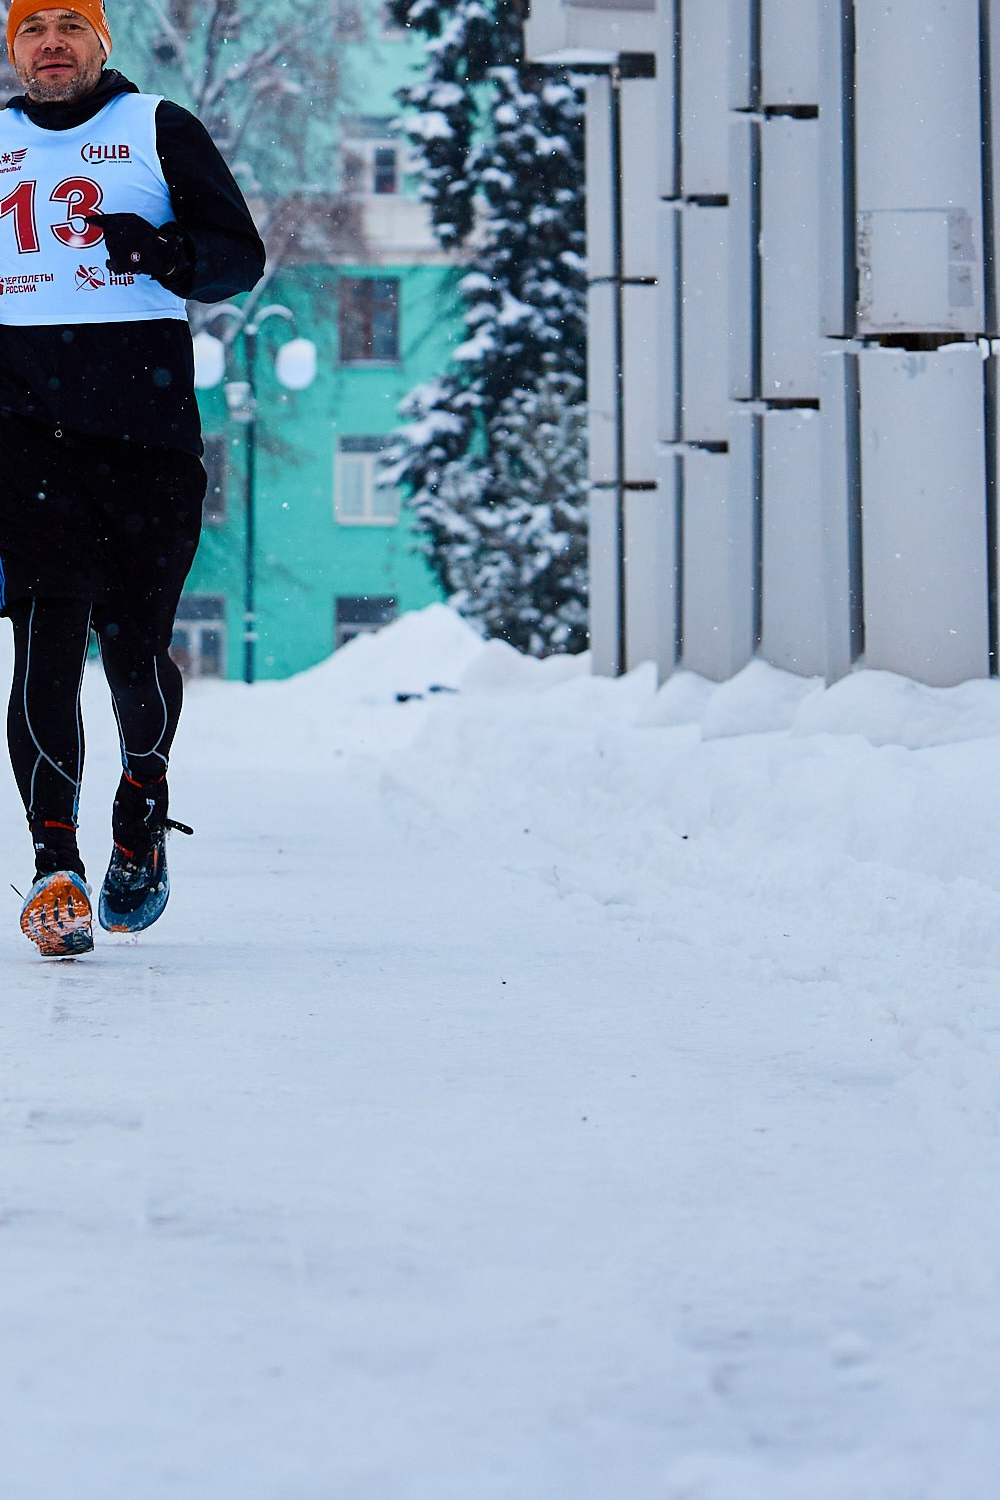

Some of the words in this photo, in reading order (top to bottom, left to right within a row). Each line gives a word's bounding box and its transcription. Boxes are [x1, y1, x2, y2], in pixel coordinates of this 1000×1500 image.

[89, 144, 130, 160] НЦВ
[110, 276, 135, 286] НЦВ
[6, 284, 37, 294] РОССИИ
